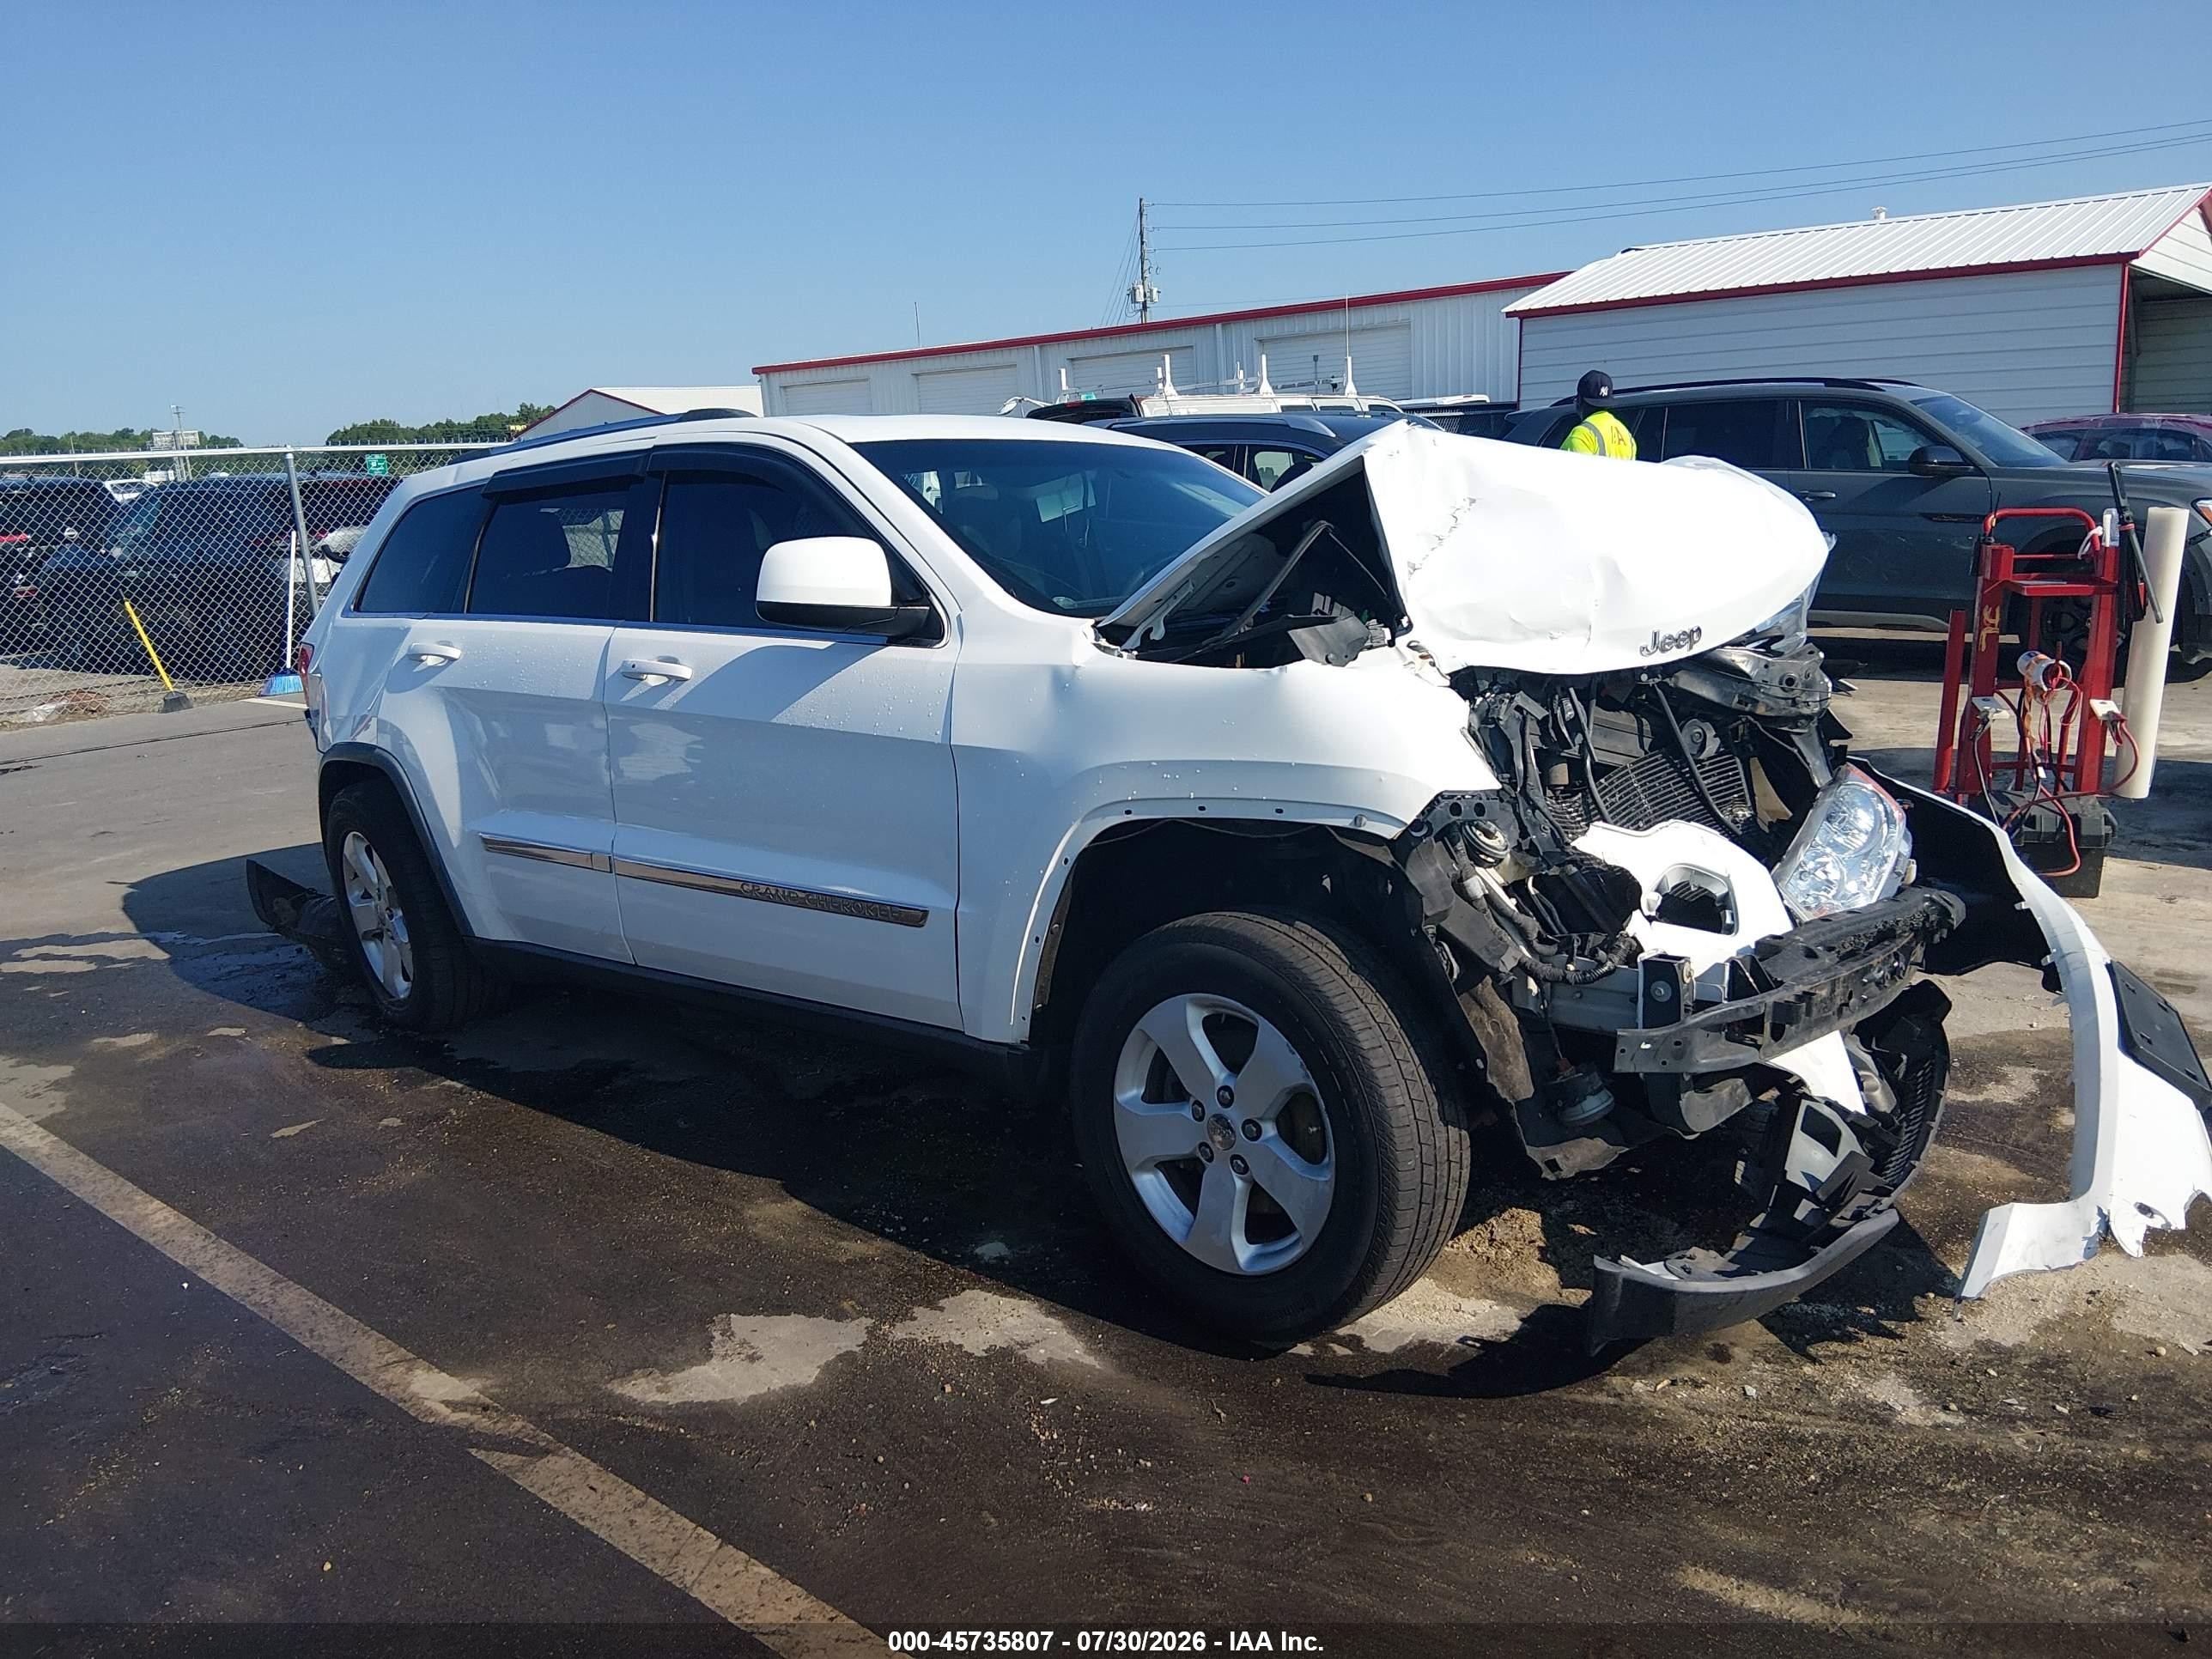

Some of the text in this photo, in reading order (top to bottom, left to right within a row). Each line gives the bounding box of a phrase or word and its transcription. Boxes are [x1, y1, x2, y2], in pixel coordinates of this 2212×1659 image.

[1639, 625, 1702, 657] Jeep
[740, 882, 901, 918] GRAND CHEROKEE
